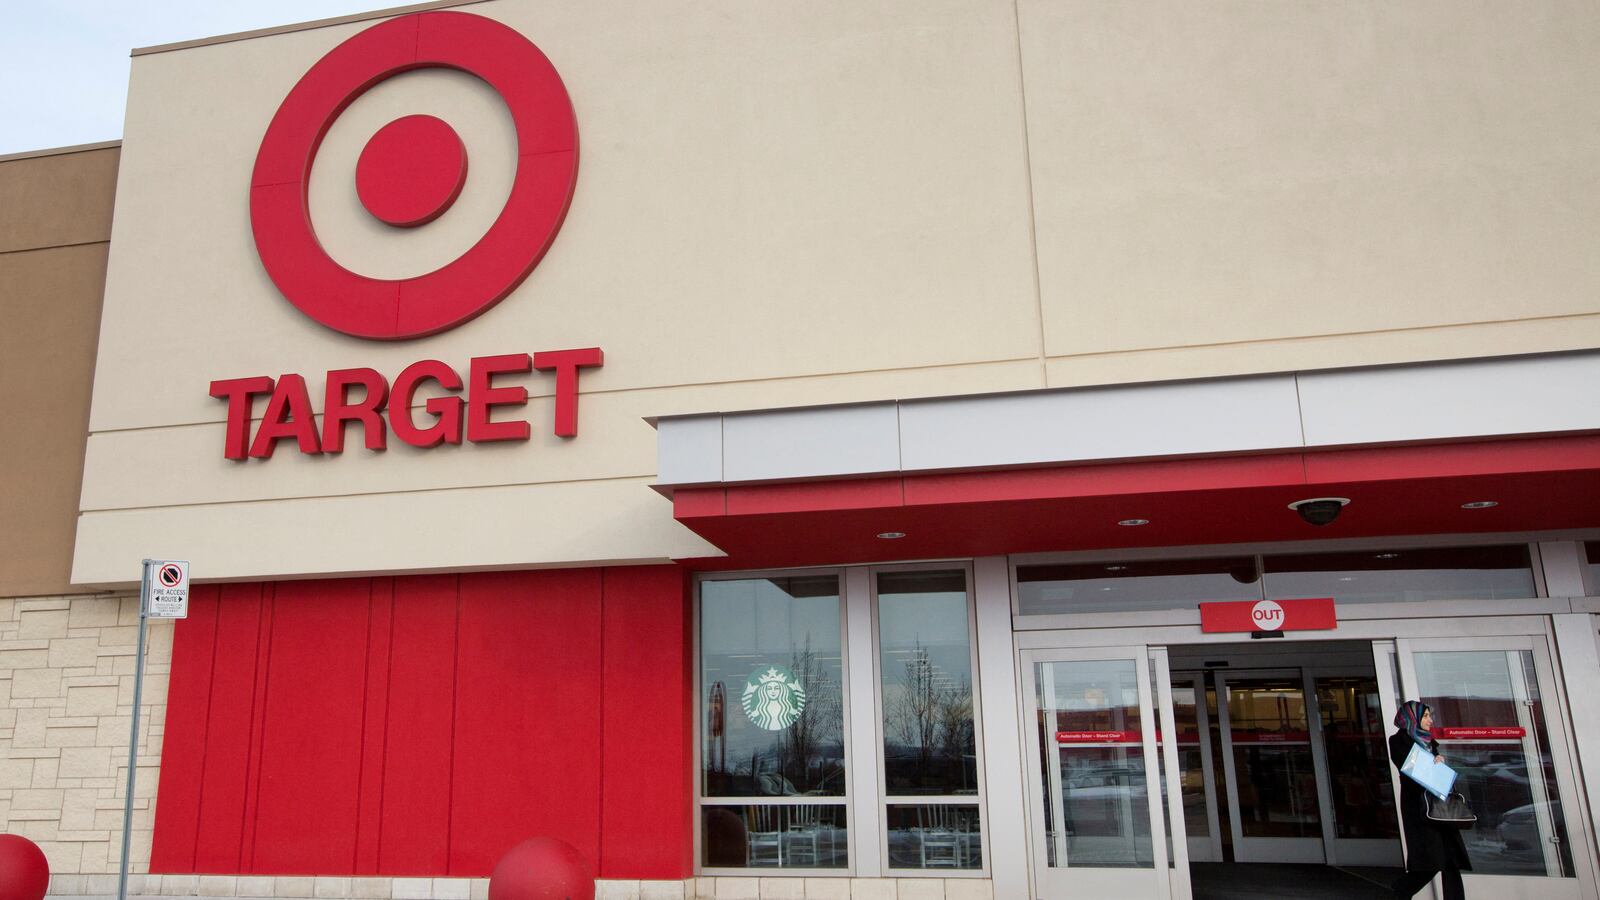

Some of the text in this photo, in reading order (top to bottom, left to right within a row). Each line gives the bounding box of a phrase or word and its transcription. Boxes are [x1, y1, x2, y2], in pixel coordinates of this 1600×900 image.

[209, 347, 604, 461] TARGET
[153, 588, 186, 596] FIRE ACCESS
[1253, 609, 1281, 621] OUT
